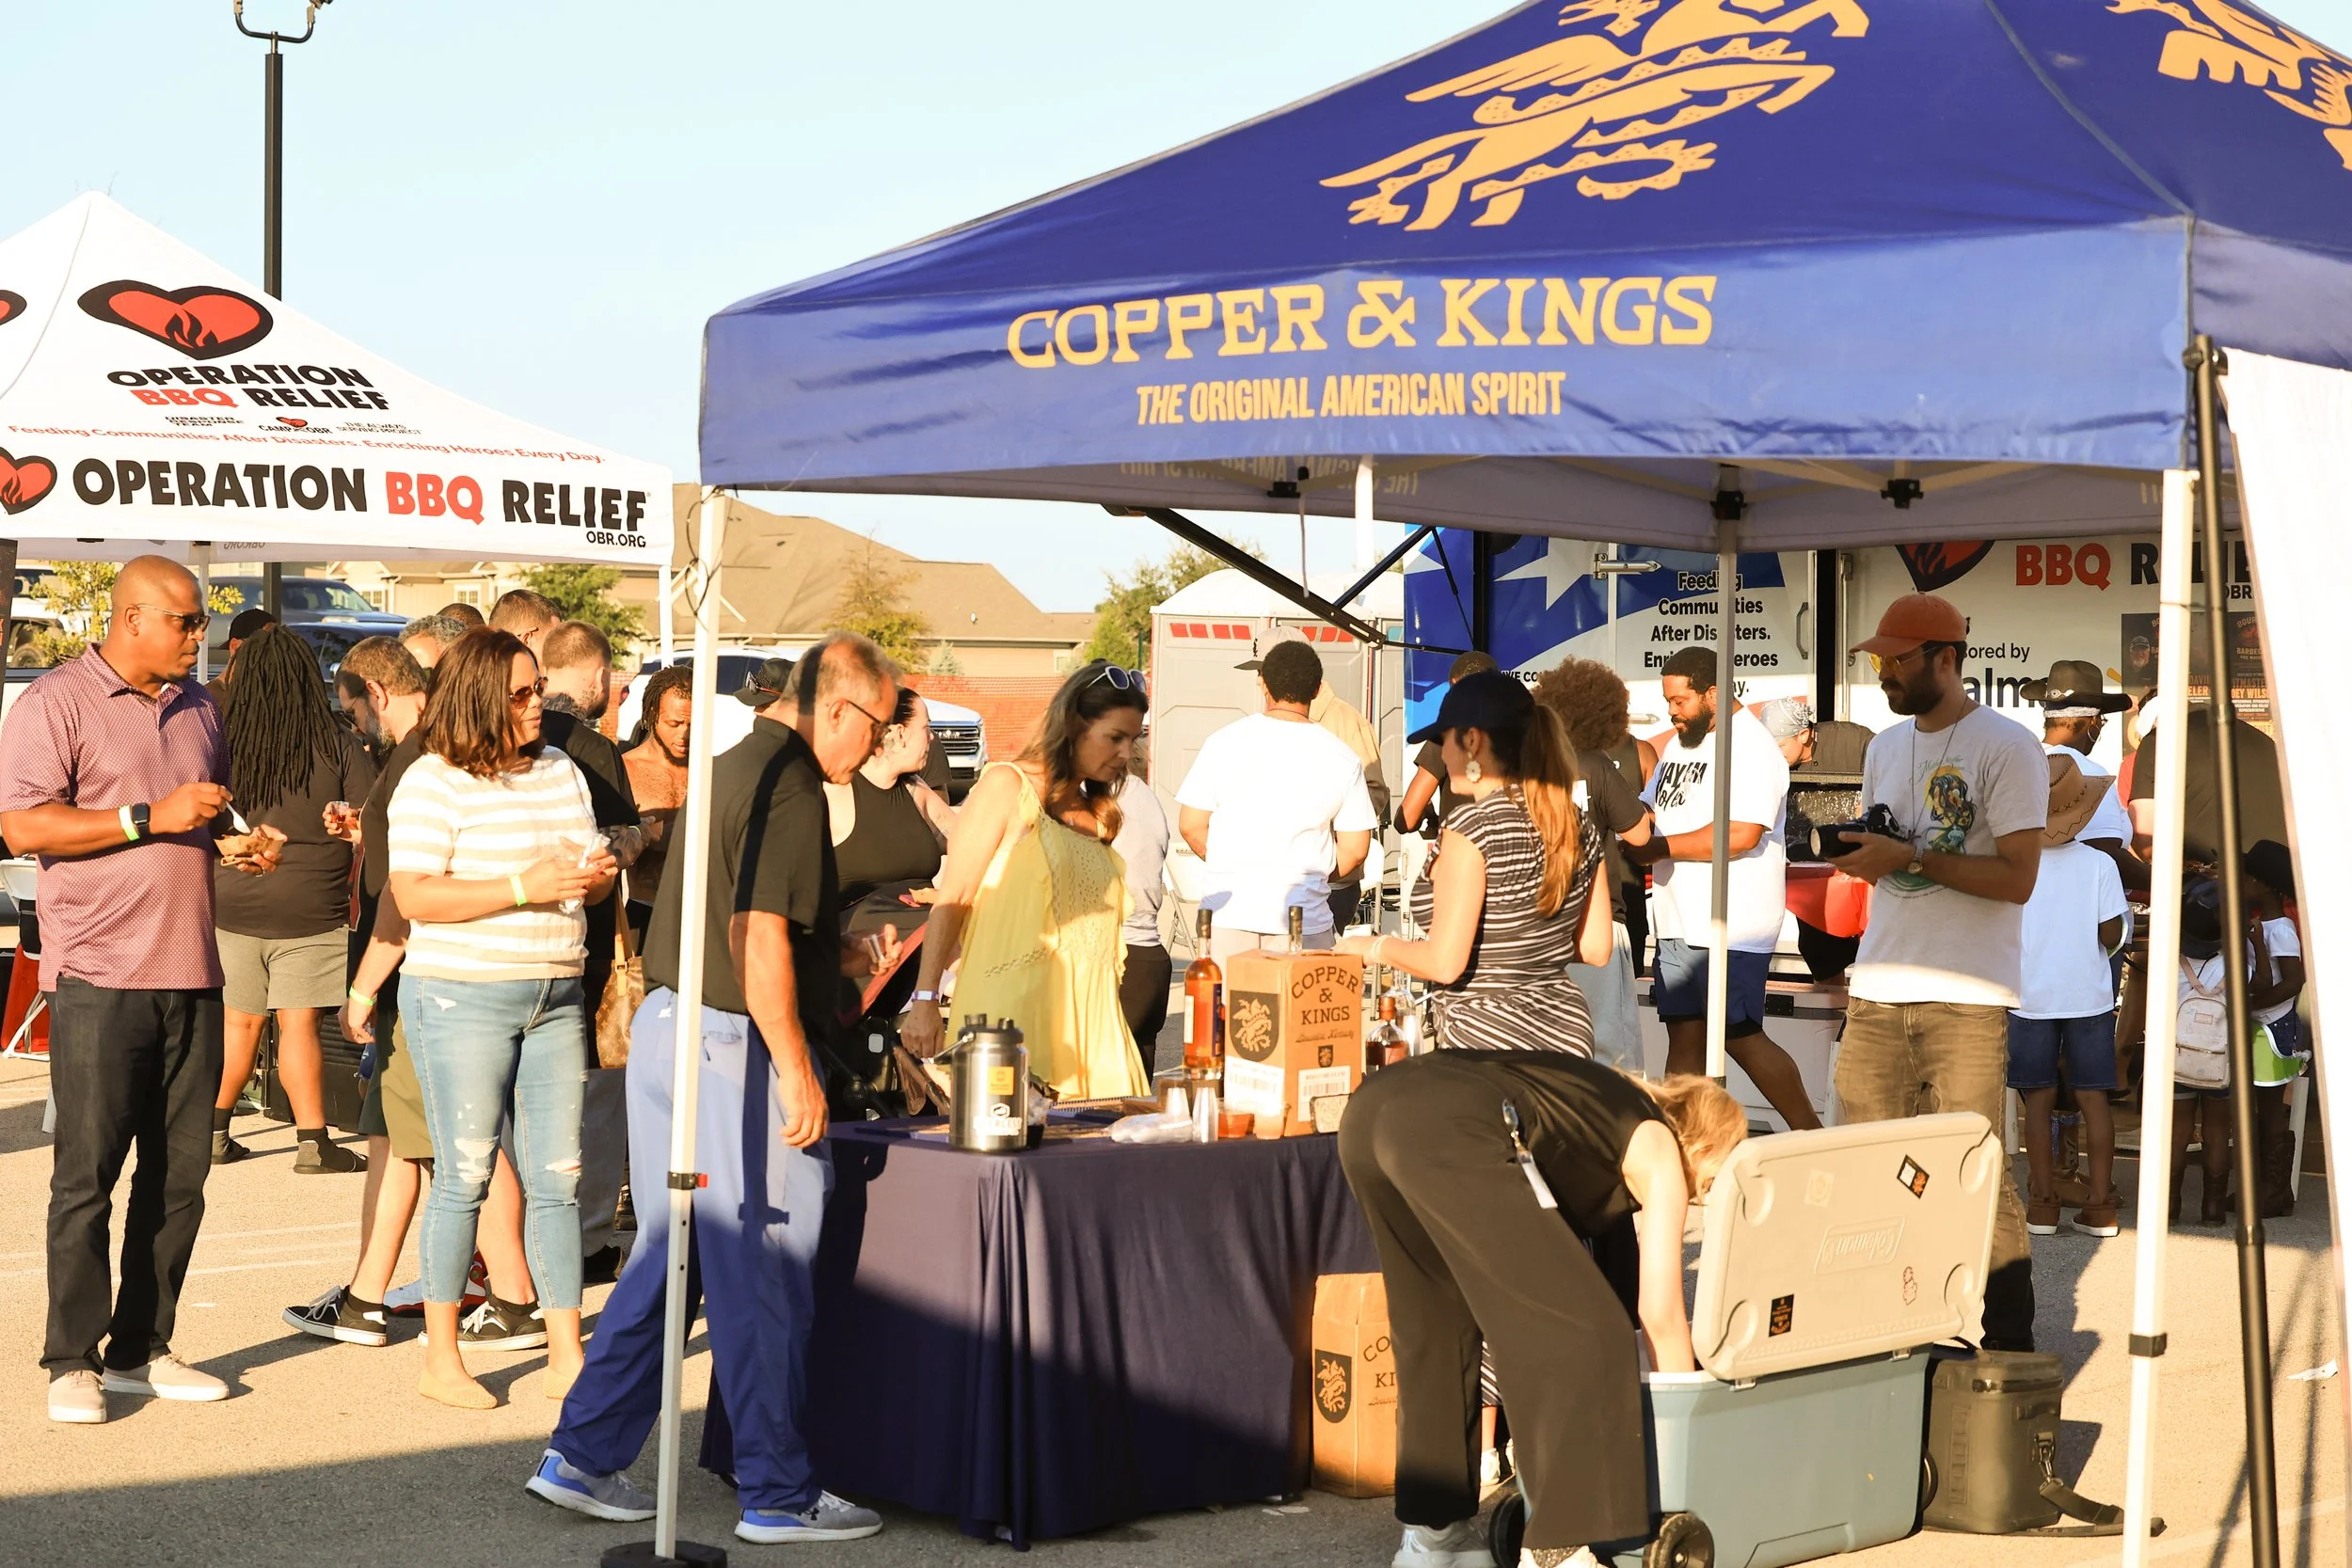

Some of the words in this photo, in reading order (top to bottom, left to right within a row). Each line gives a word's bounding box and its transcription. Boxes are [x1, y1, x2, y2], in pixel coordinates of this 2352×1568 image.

[1008, 284, 1327, 369] COPPER
[1347, 279, 1417, 349] &
[1437, 276, 1717, 348] KINGS
[107, 364, 374, 388] OPERATION
[130, 388, 239, 408] BBQ
[242, 388, 389, 410] RELIEF
[1136, 383, 1184, 426] THE
[1190, 376, 1315, 423] ORIGINAL
[1320, 373, 1465, 419] AMERICAN
[1471, 372, 1566, 416] SPIRIT
[8, 425, 91, 437] Feeding
[91, 428, 220, 441] Communities
[222, 434, 268, 443] After
[270, 436, 362, 447] Disasters.
[362, 439, 451, 454] Enriching
[451, 444, 515, 456] Heroes
[515, 448, 566, 462] Every
[565, 451, 606, 464] Day.
[72, 458, 368, 513] OPERATION
[386, 470, 485, 526] BBQ
[502, 479, 646, 532] RELIEF
[586, 531, 646, 548] OBR.ORG
[2016, 542, 2111, 592] BBQ
[1658, 597, 1764, 616] Commuties
[1650, 624, 1692, 642] After
[1694, 624, 1771, 641] Disters.
[1734, 653, 1779, 668] eroes
[2010, 642, 2030, 663] by
[1291, 965, 1359, 1000] COPPER
[1319, 988, 1333, 1004] &
[1301, 1006, 1350, 1026] KINGS
